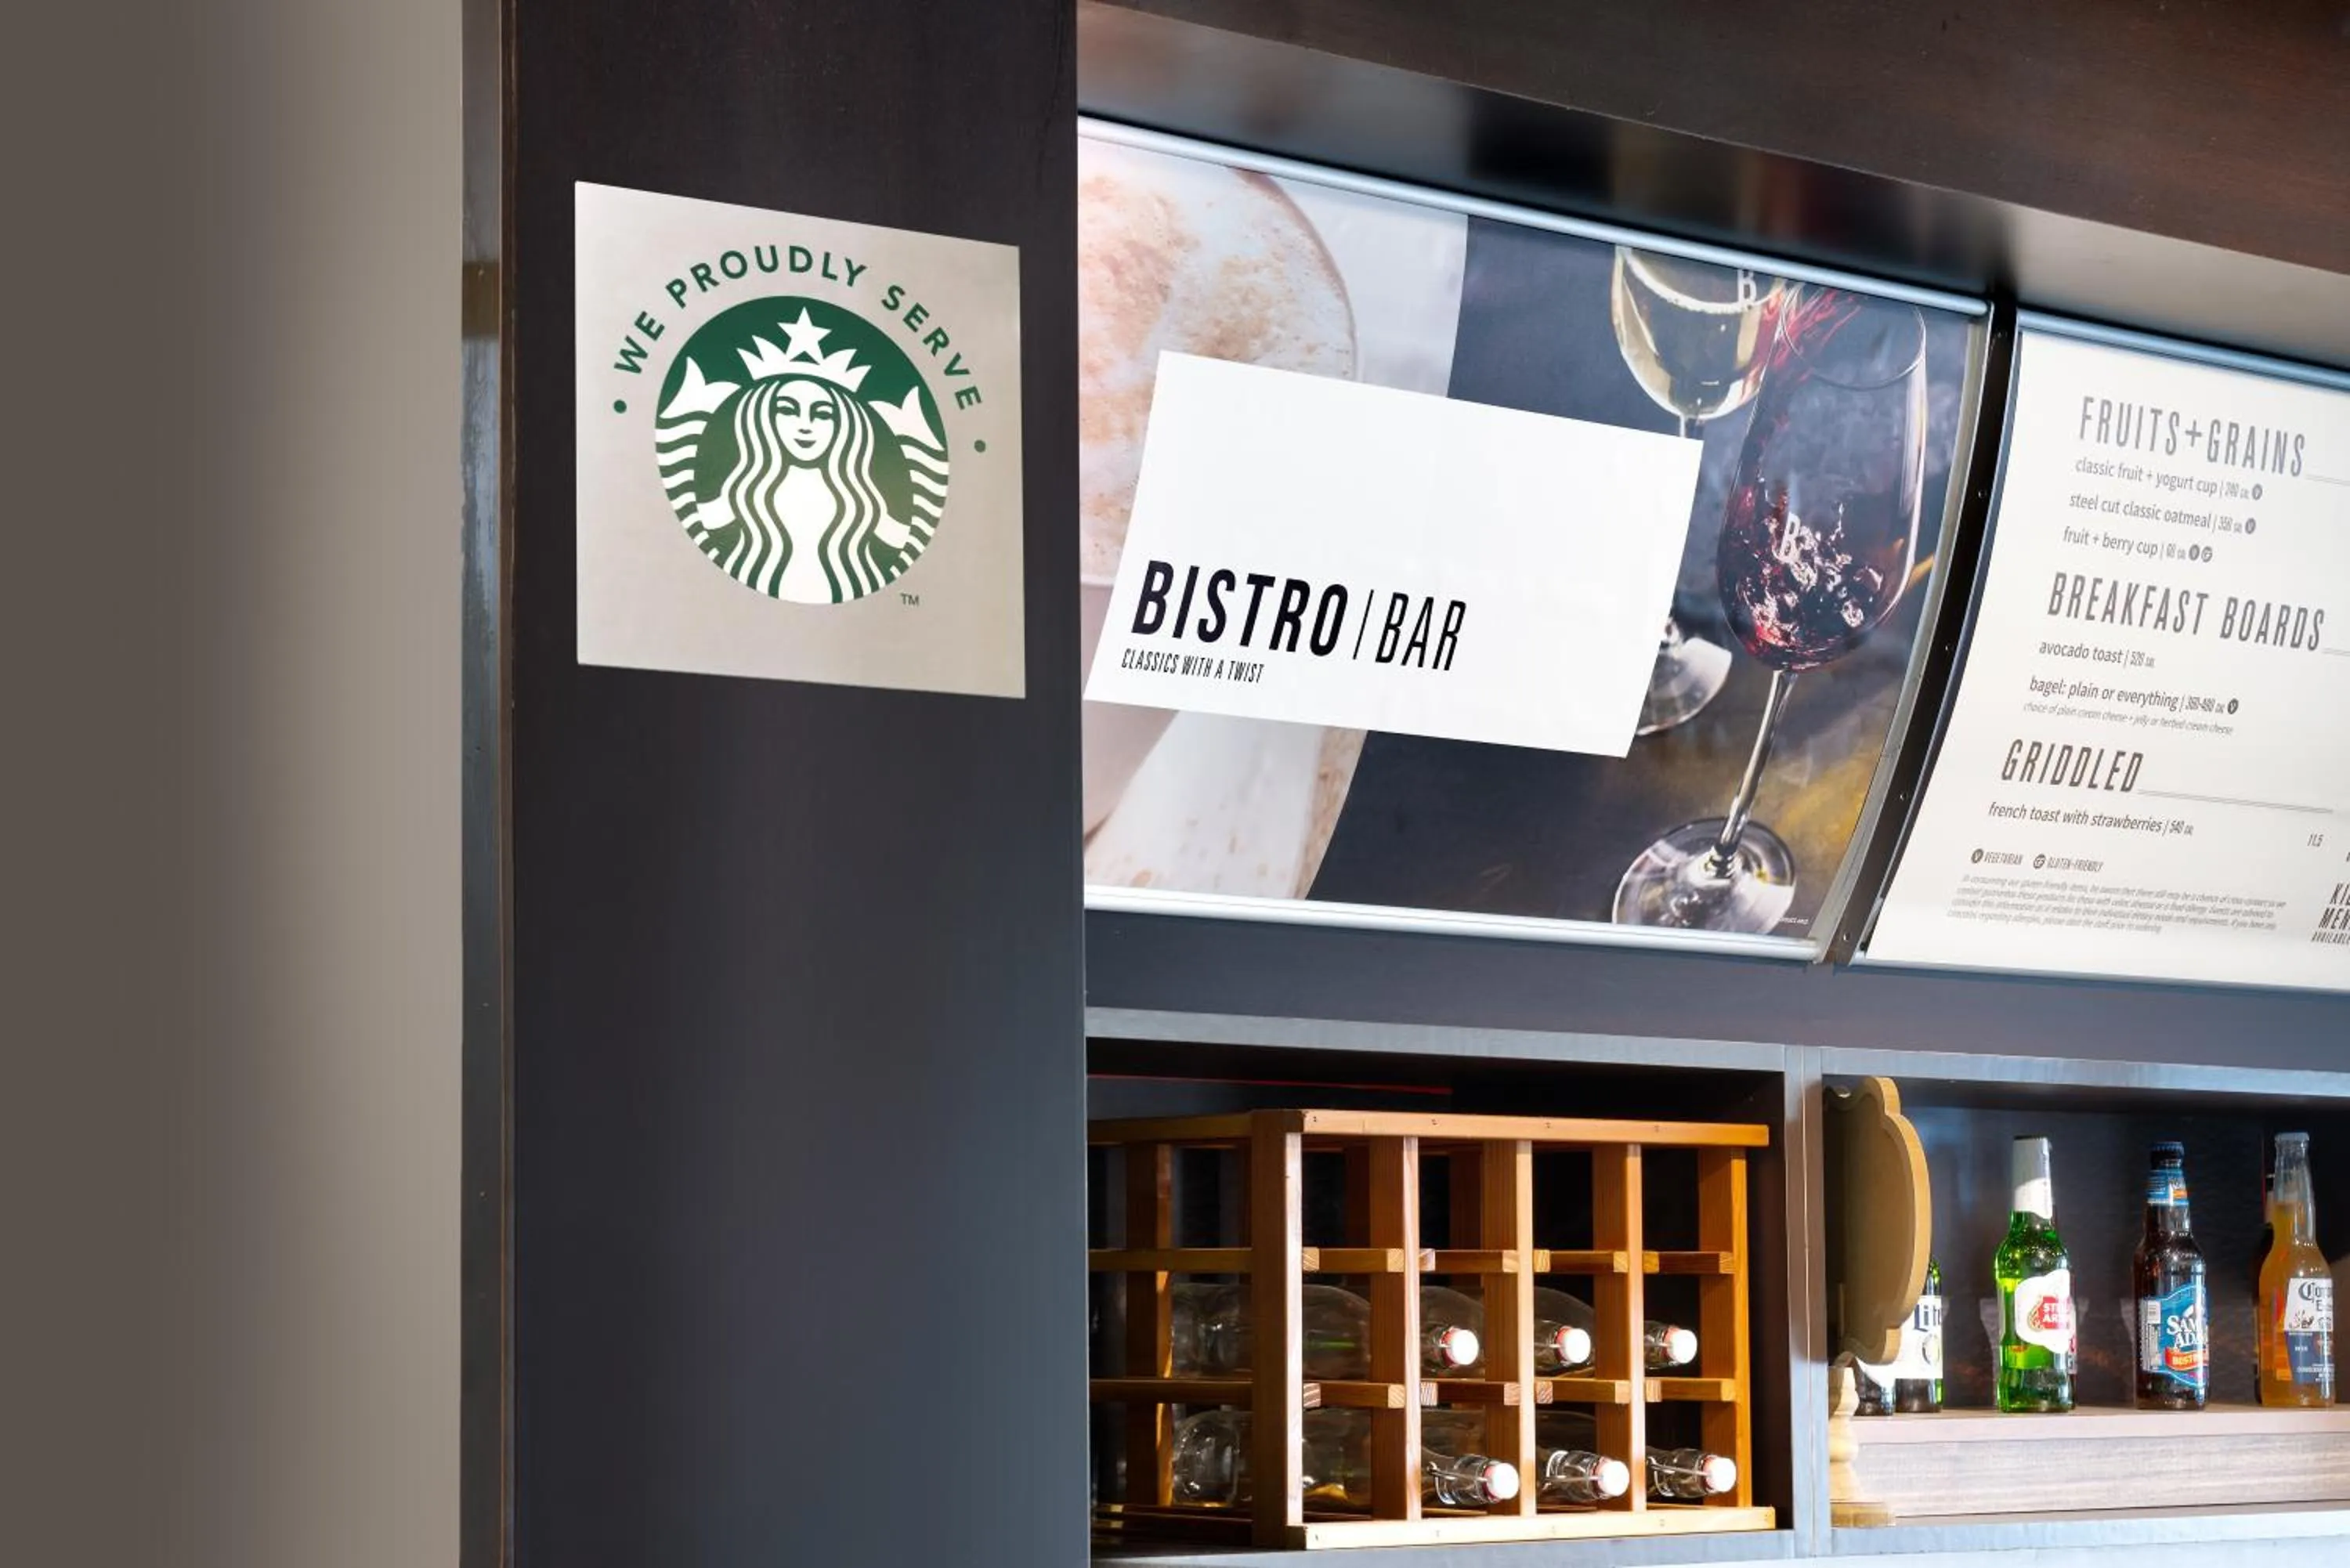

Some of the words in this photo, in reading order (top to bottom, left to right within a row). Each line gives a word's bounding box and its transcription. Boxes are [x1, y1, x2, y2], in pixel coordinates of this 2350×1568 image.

[613, 311, 666, 376] WE
[665, 245, 867, 309] PROUDLY
[881, 284, 982, 410] SERVE
[2075, 457, 2115, 477] classic
[2117, 462, 2143, 482] fruit
[2155, 471, 2194, 492] yogurt
[2196, 479, 2218, 498] cup
[2069, 493, 2099, 511] steel
[2101, 499, 2120, 515] cut
[2122, 501, 2162, 522] classic
[2164, 511, 2212, 529] oatmeal
[2062, 526, 2091, 546] fruit
[2102, 532, 2135, 556] berry
[2136, 540, 2158, 559] cup
[900, 593, 920, 607] TM
[1130, 560, 1349, 657] BISTRO
[1375, 591, 1467, 671] BAR
[2047, 572, 2210, 635] BREAKFAST
[2219, 596, 2325, 652] BOARDS
[1121, 648, 1180, 674] CLASSICS
[1181, 655, 1213, 677] WITH
[1214, 659, 1224, 680] A
[1227, 660, 1265, 684] TWIST
[2039, 641, 2090, 659] avocado
[2092, 648, 2124, 664] toast
[2030, 674, 2066, 698] bagel:
[2068, 680, 2100, 699] plain
[2102, 687, 2115, 700] or
[2117, 688, 2180, 712] everything
[2001, 739, 2144, 793] GRIDDLED
[1988, 800, 2028, 821] french
[2030, 807, 2061, 823] toast
[2063, 809, 2089, 826] with
[2091, 811, 2163, 833] strawberries
